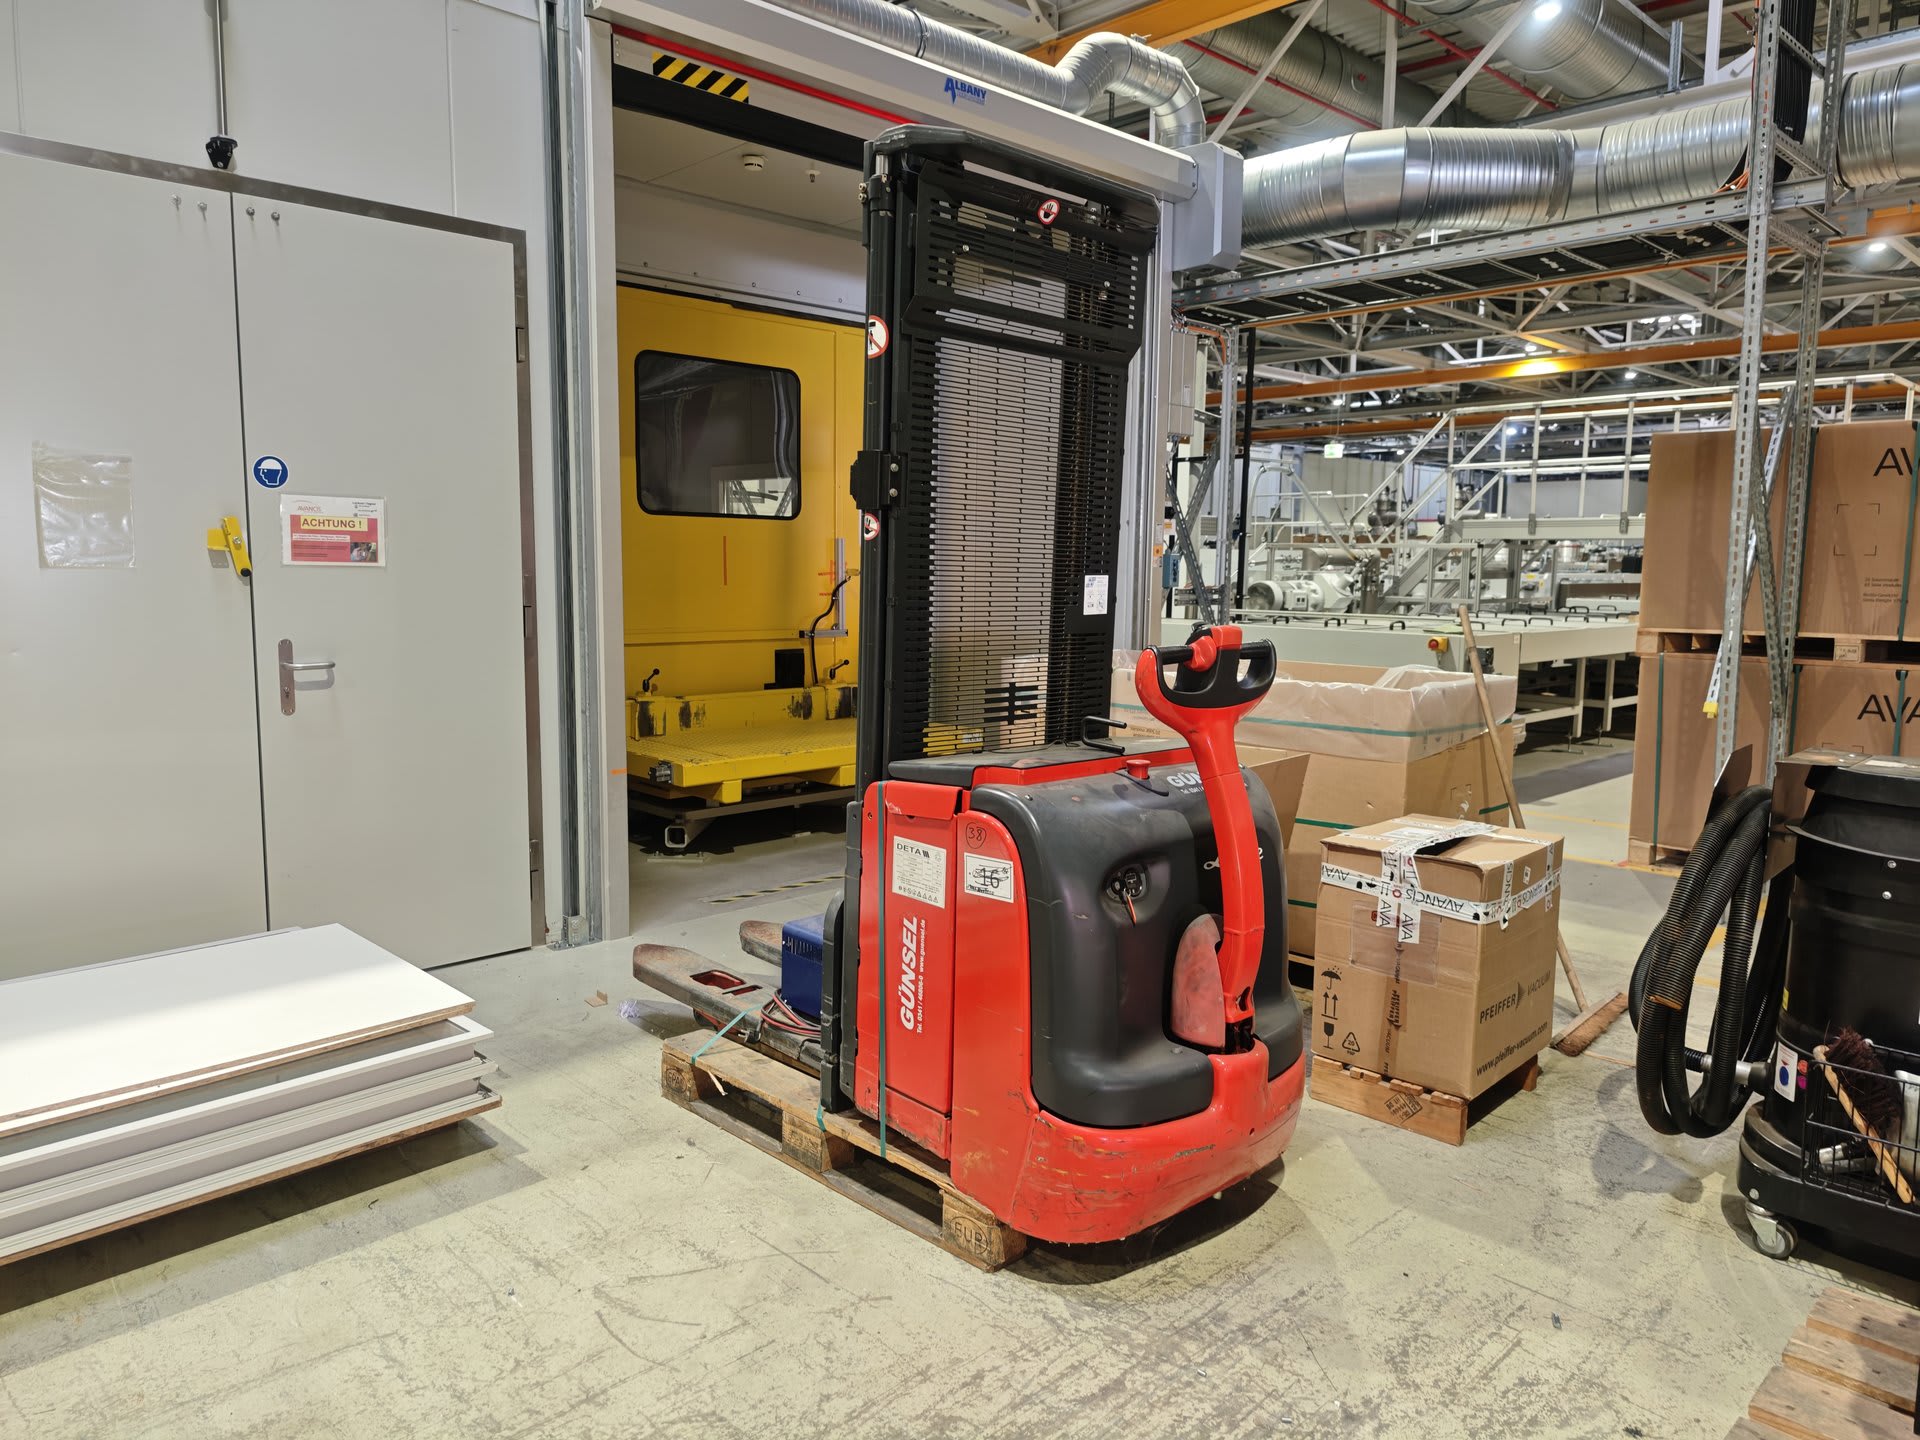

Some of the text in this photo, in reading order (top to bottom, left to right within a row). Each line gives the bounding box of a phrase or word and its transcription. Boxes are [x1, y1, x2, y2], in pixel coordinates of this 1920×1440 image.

[944, 76, 987, 104] ALBANY
[301, 518, 356, 529] ACHTUNG
[968, 826, 983, 842] 38
[896, 843, 921, 856] DETA
[1405, 888, 1465, 913] AVANCIS
[1401, 912, 1414, 941] AVA
[898, 916, 918, 1031] GÜNSEL
[1480, 993, 1517, 1024] PFEIFFER
[1476, 1022, 1548, 1077] www.pfeiffer-vacuum.com
